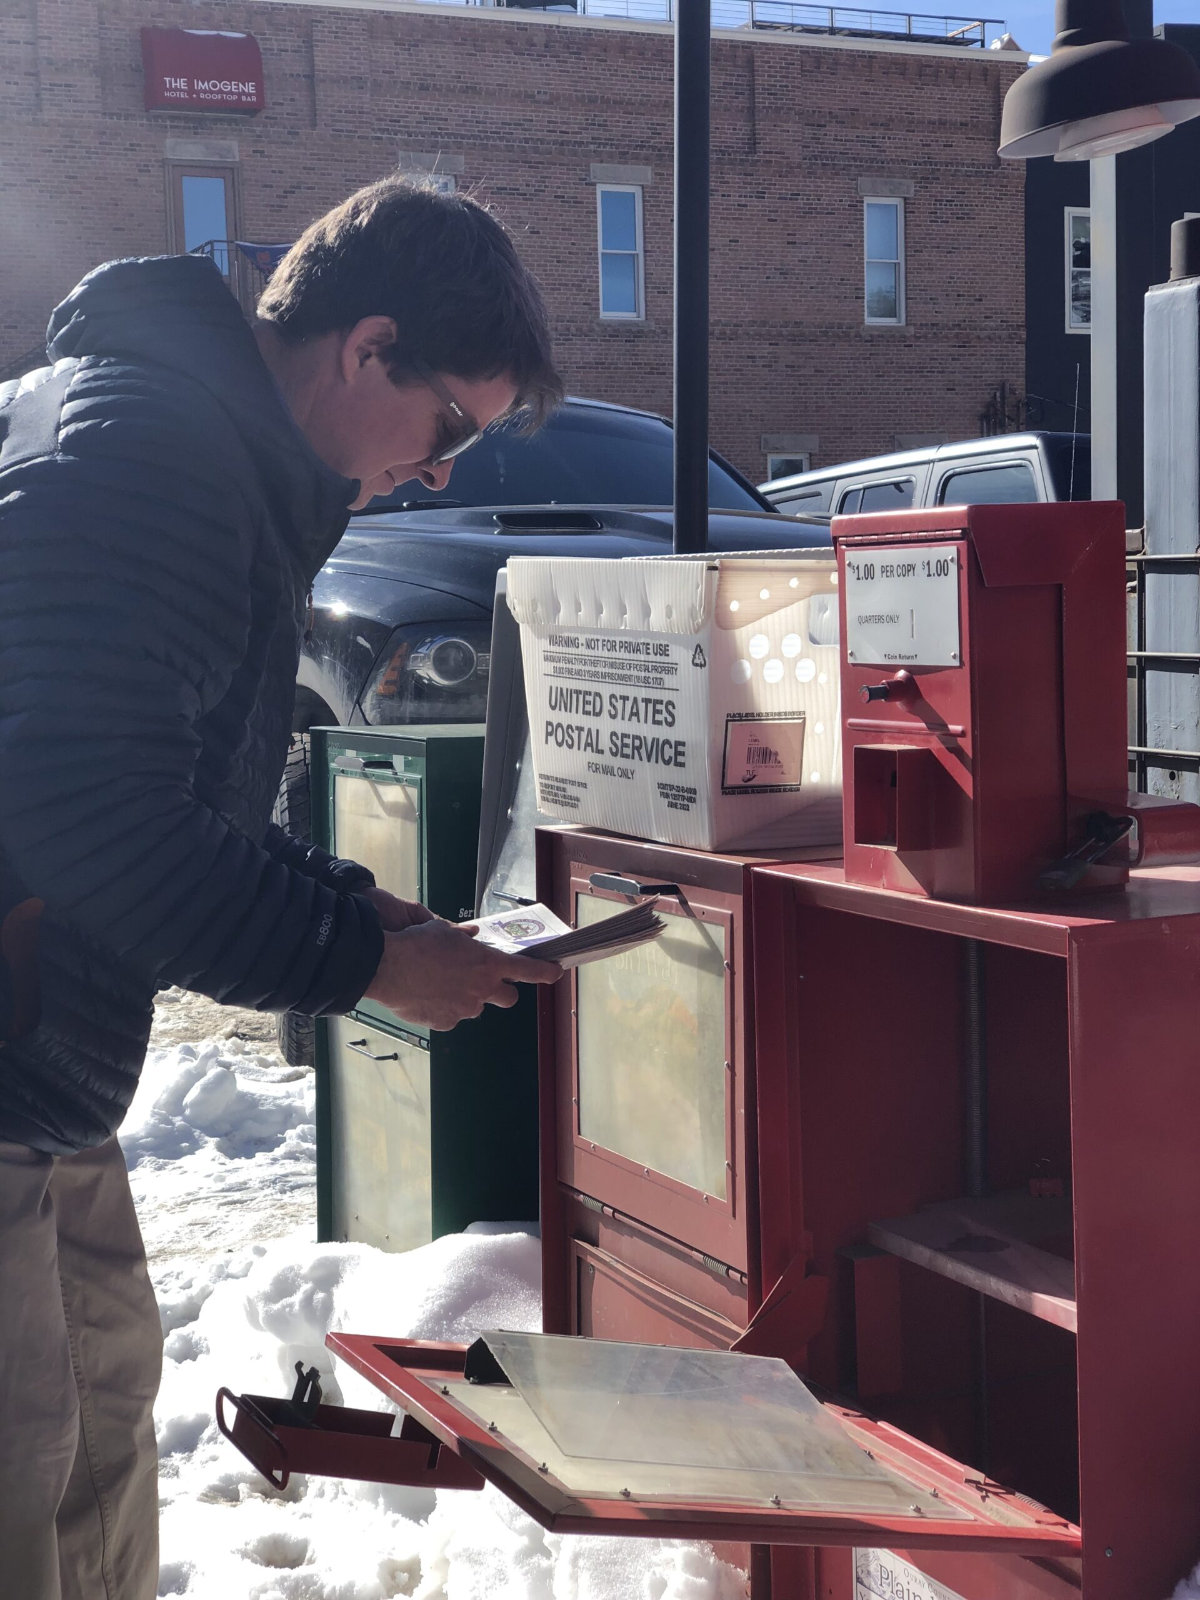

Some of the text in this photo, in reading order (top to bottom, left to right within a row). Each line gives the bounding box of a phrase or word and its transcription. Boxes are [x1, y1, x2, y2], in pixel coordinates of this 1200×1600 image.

[164, 77, 256, 93] THE IMOGENE
[200, 92, 238, 101] ROOFTOP
[880, 565, 895, 578] PER
[896, 563, 917, 578] COPY
[922, 559, 949, 578] $1.00
[857, 614, 900, 626] QUARTERS ONLY
[549, 634, 580, 649] WARNING
[585, 637, 600, 651] NOT
[601, 638, 617, 652] FOR
[619, 640, 651, 656] PRIVATE
[653, 642, 670, 657] USE
[651, 664, 678, 676] PROPERTY
[549, 685, 676, 727] UNITED STATES
[545, 720, 686, 768] POSTAL SERVICE
[587, 761, 635, 780] FOR MAIL ONLY
[458, 908, 474, 918] Ser
[879, 1563, 934, 1600] Plai
